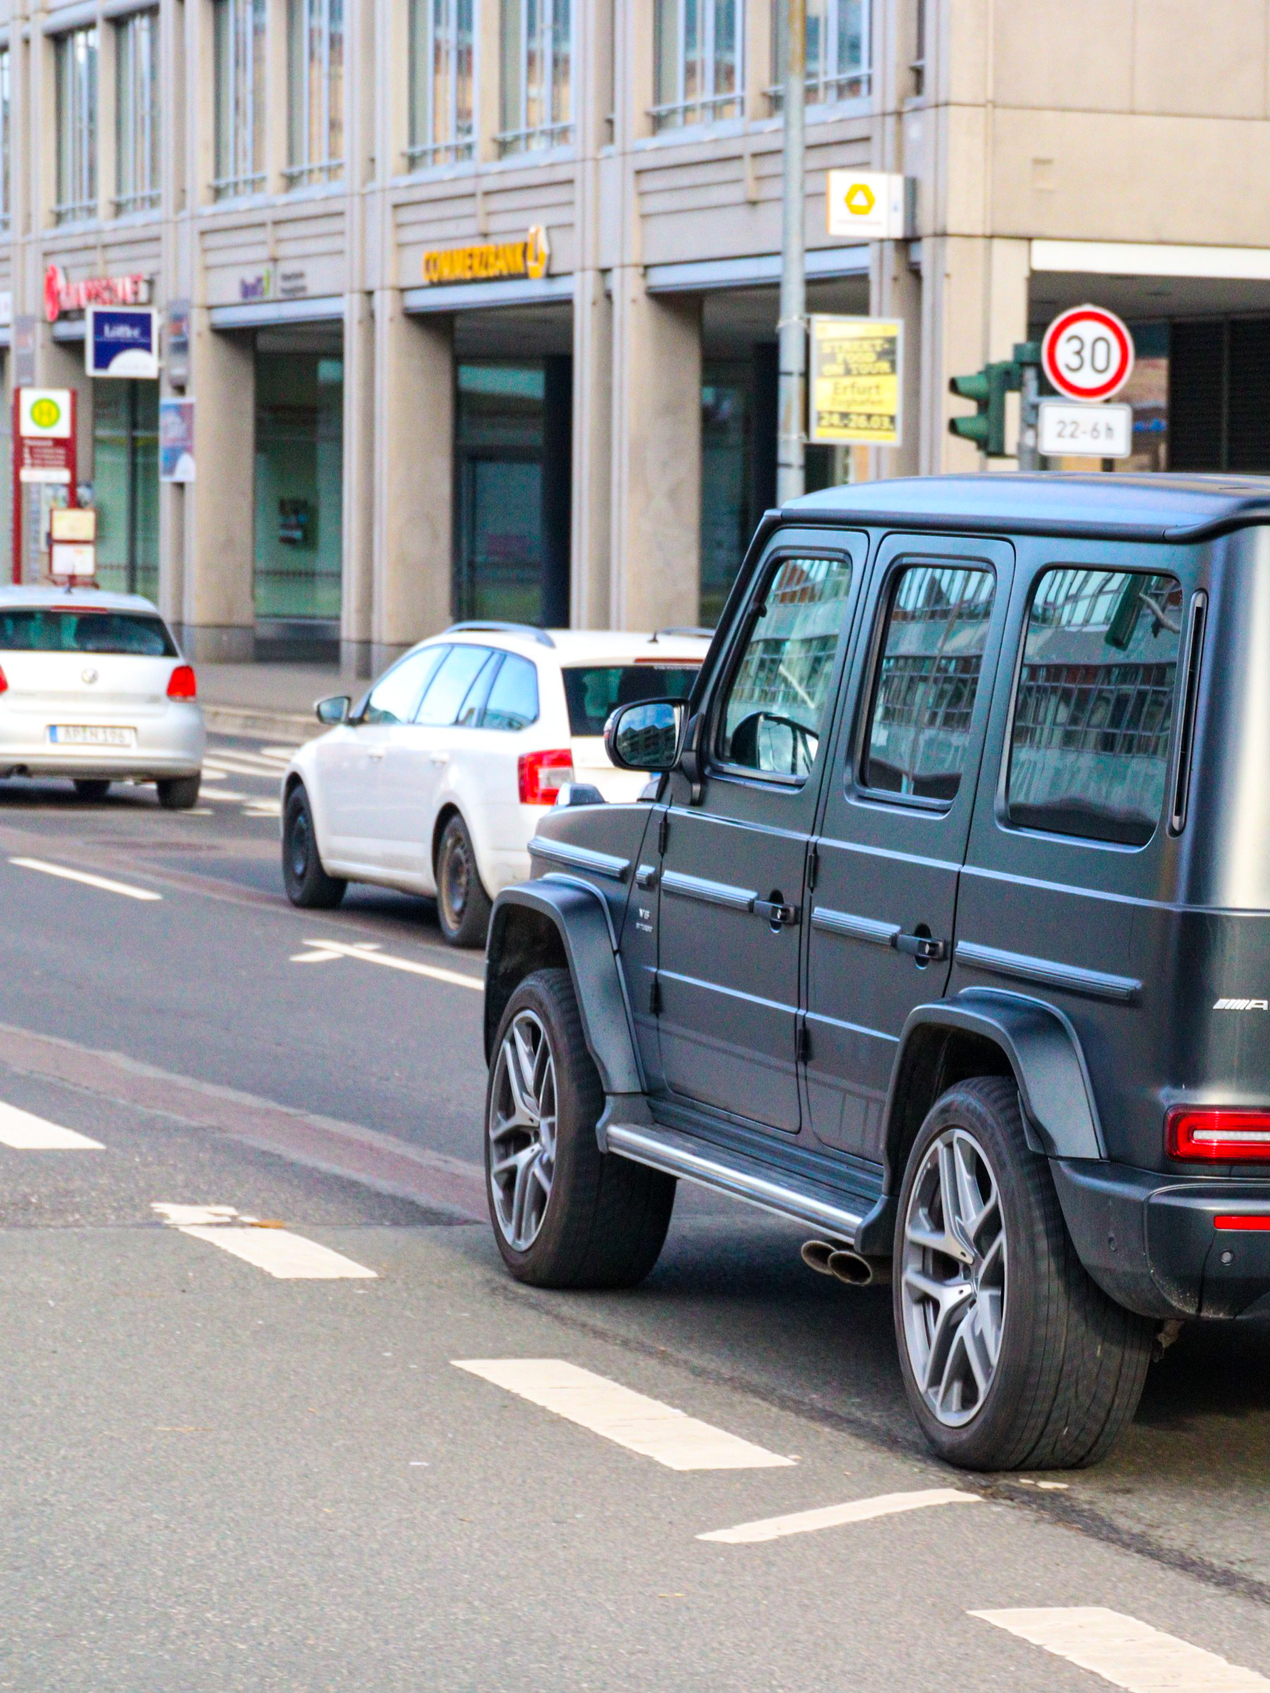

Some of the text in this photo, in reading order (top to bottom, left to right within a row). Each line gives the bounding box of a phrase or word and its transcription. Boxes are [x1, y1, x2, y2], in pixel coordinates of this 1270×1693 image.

[423, 242, 525, 282] COMMERZBANK
[1065, 335, 1111, 374] 30
[833, 381, 882, 396] Erfurt
